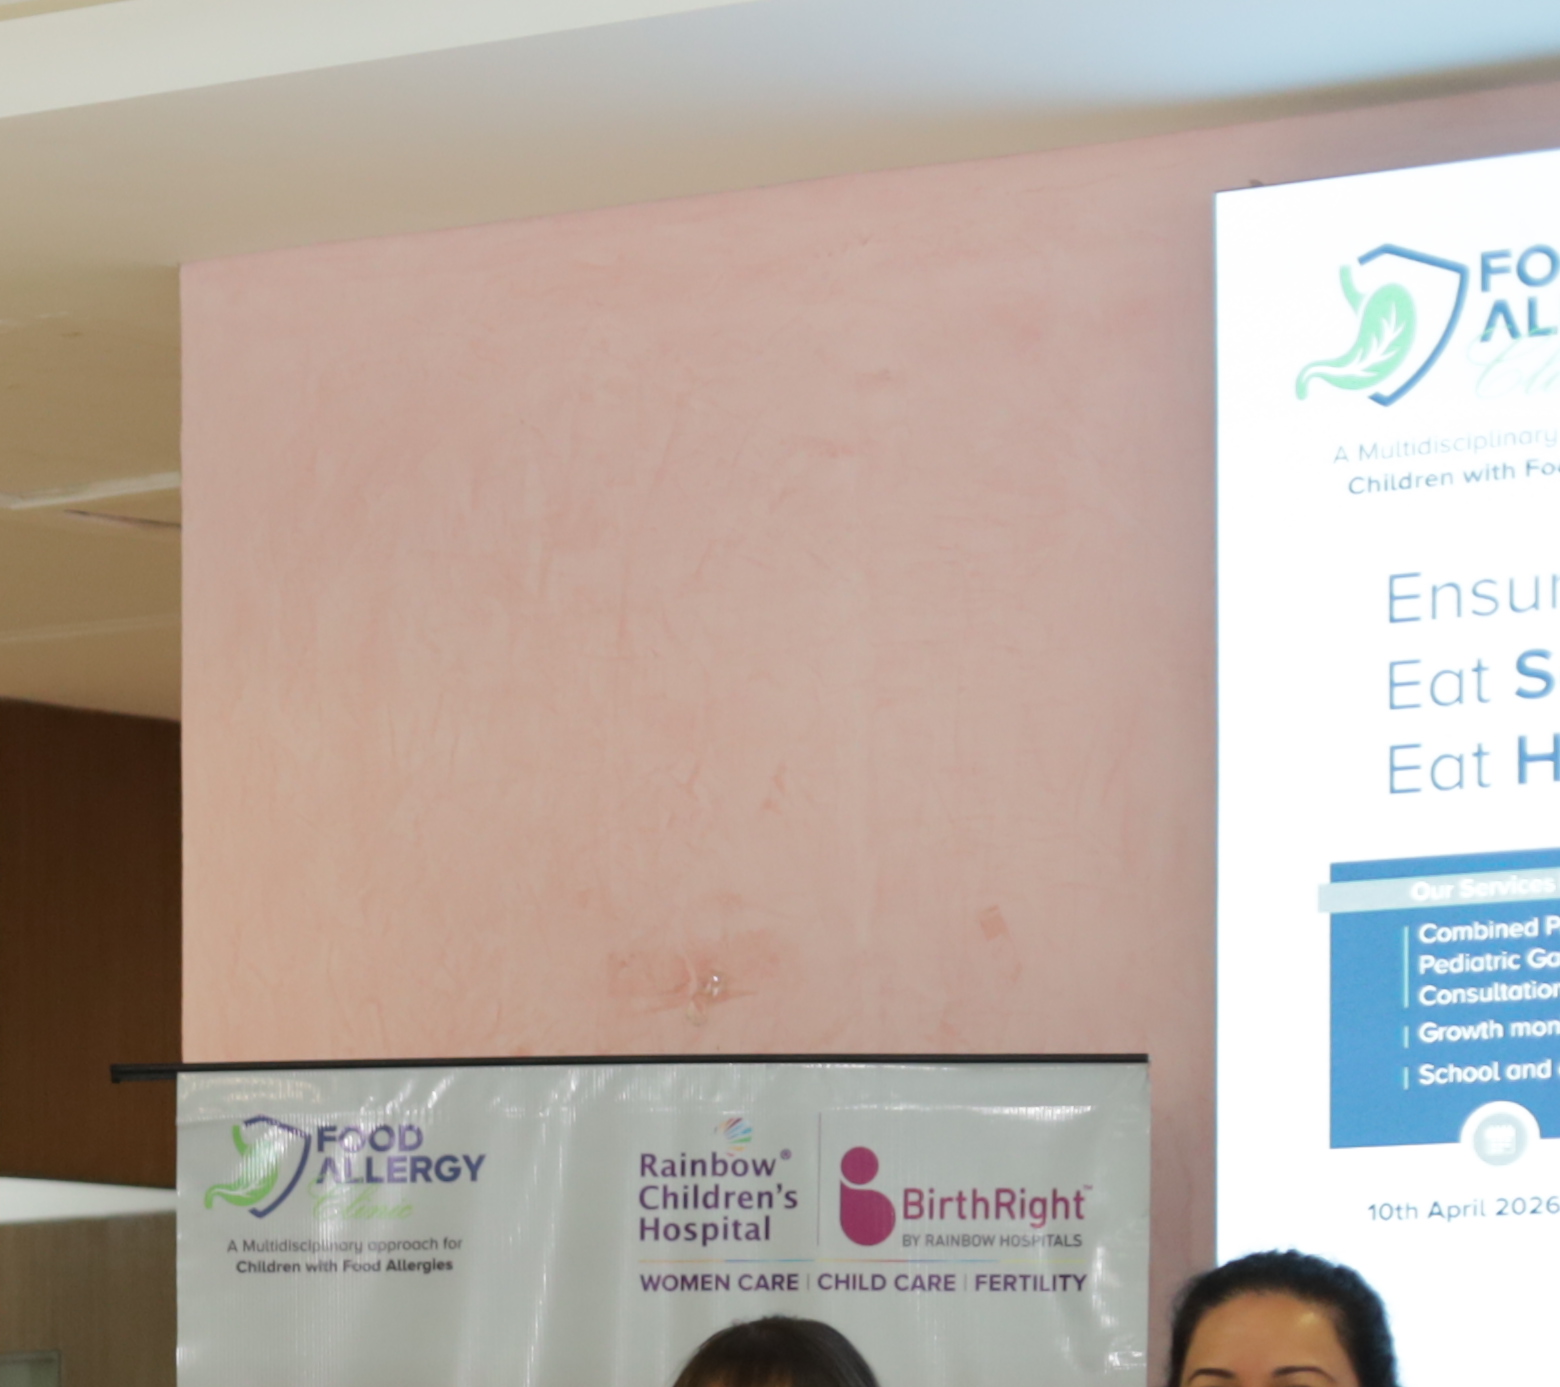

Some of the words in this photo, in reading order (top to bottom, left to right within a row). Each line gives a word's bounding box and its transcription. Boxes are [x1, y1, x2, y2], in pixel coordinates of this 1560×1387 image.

[1334, 446, 1349, 463] A
[1359, 428, 1557, 462] Multidisciplinary
[1349, 471, 1454, 495] Children
[1463, 462, 1515, 483] with
[1389, 658, 1491, 710] Eat
[1389, 743, 1492, 794] Eat
[1410, 881, 1454, 901] Our
[1460, 875, 1555, 898] Services
[1419, 917, 1538, 943] Combined
[1419, 951, 1521, 975] Pediatric
[1419, 1020, 1504, 1043] Growth
[1419, 1061, 1500, 1085] School
[1506, 1059, 1552, 1081] and
[317, 1124, 423, 1152] FOOD
[317, 1154, 486, 1184] ALLERGY
[639, 1183, 798, 1210] Children's
[1368, 1202, 1418, 1221] 10th
[1427, 1199, 1485, 1222] April
[1496, 1196, 1560, 1216] 2026
[639, 1215, 771, 1247] Hospital
[902, 1234, 920, 1247] BY
[925, 1234, 996, 1247] RAINBOW
[1000, 1234, 1082, 1247] HOSPITALS
[227, 1240, 238, 1252] A
[243, 1239, 363, 1254] Multidisciplinary
[367, 1238, 438, 1254] approach
[444, 1237, 462, 1250] for
[236, 1260, 300, 1273] Children
[305, 1260, 337, 1273] with
[343, 1259, 381, 1272] Food
[386, 1259, 453, 1275] Allergies
[640, 1274, 730, 1292] WOMEN
[738, 1273, 799, 1291] CARE
[817, 1273, 887, 1292] CHILD
[894, 1273, 956, 1291] CARE
[975, 1273, 1087, 1292] FERTILITY
